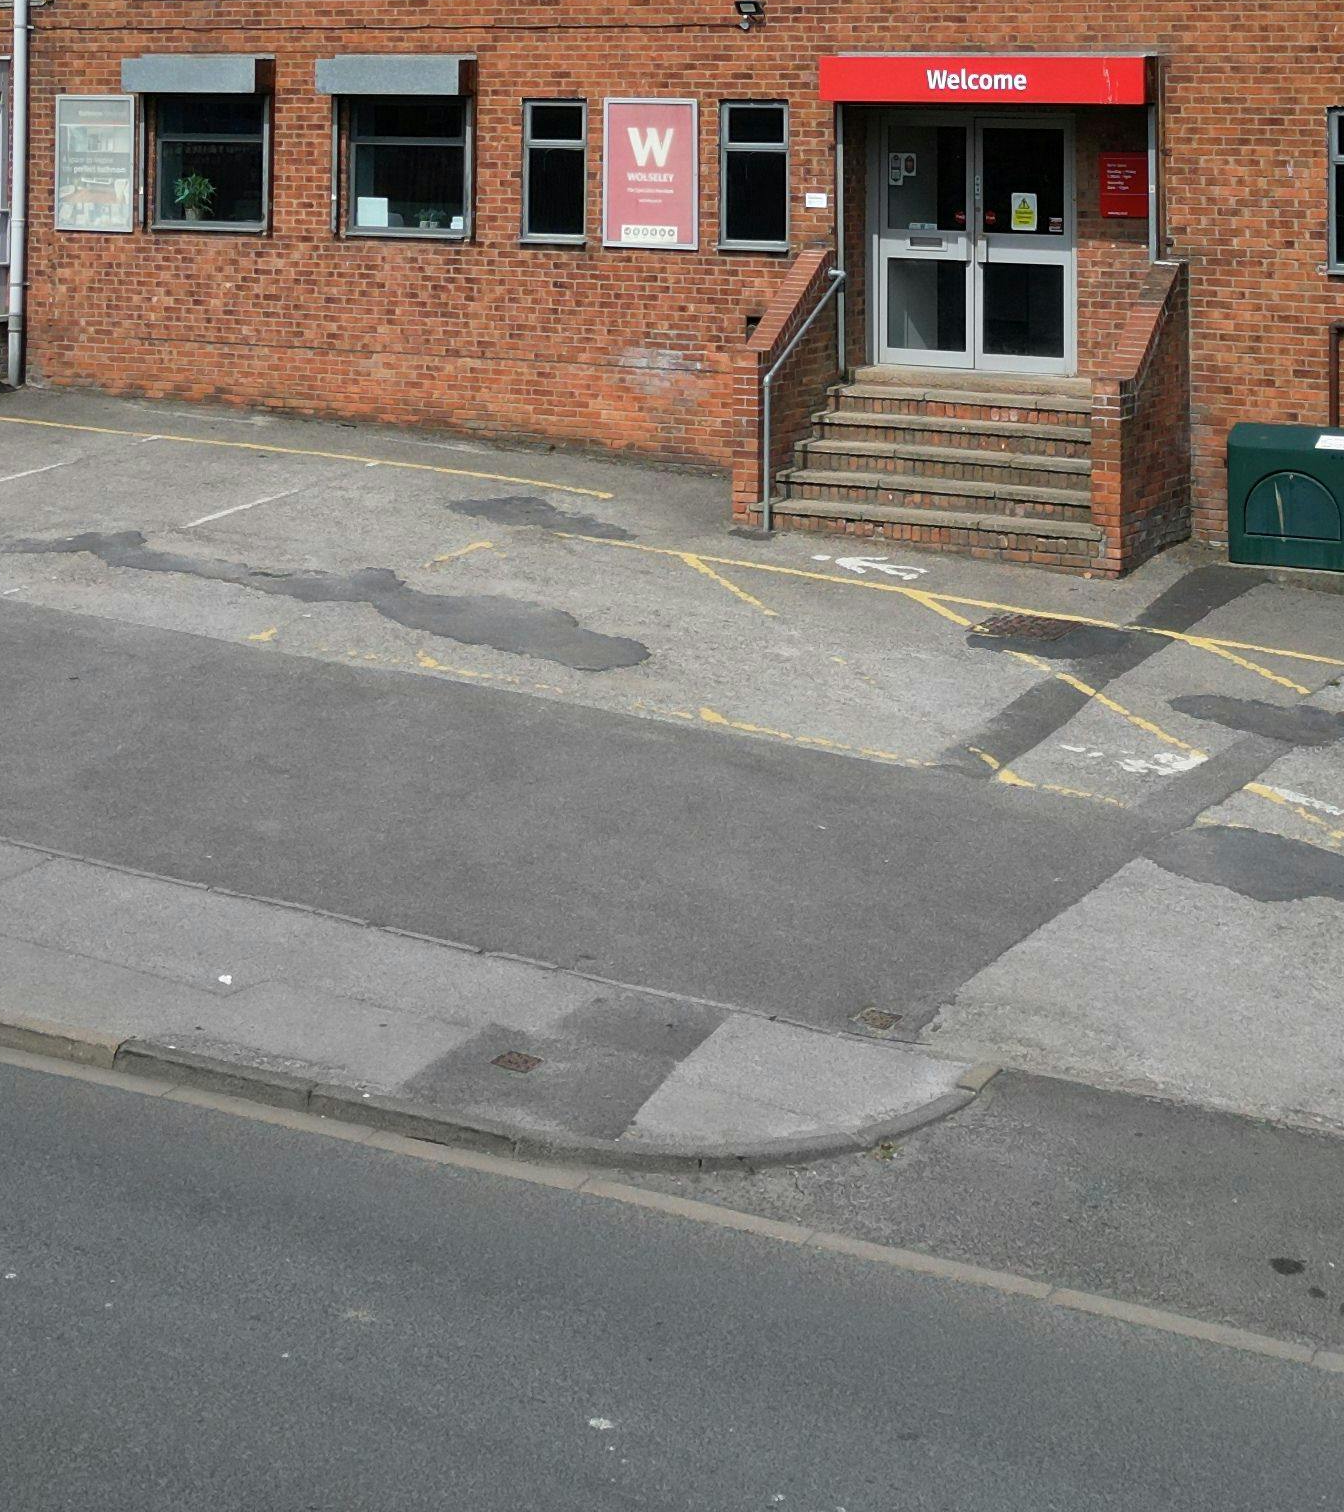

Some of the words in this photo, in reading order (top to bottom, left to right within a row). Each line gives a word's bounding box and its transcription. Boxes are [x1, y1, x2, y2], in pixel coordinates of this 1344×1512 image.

[926, 67, 1027, 90] Welcome
[627, 127, 674, 167] W
[627, 172, 674, 183] WOLSELEY
